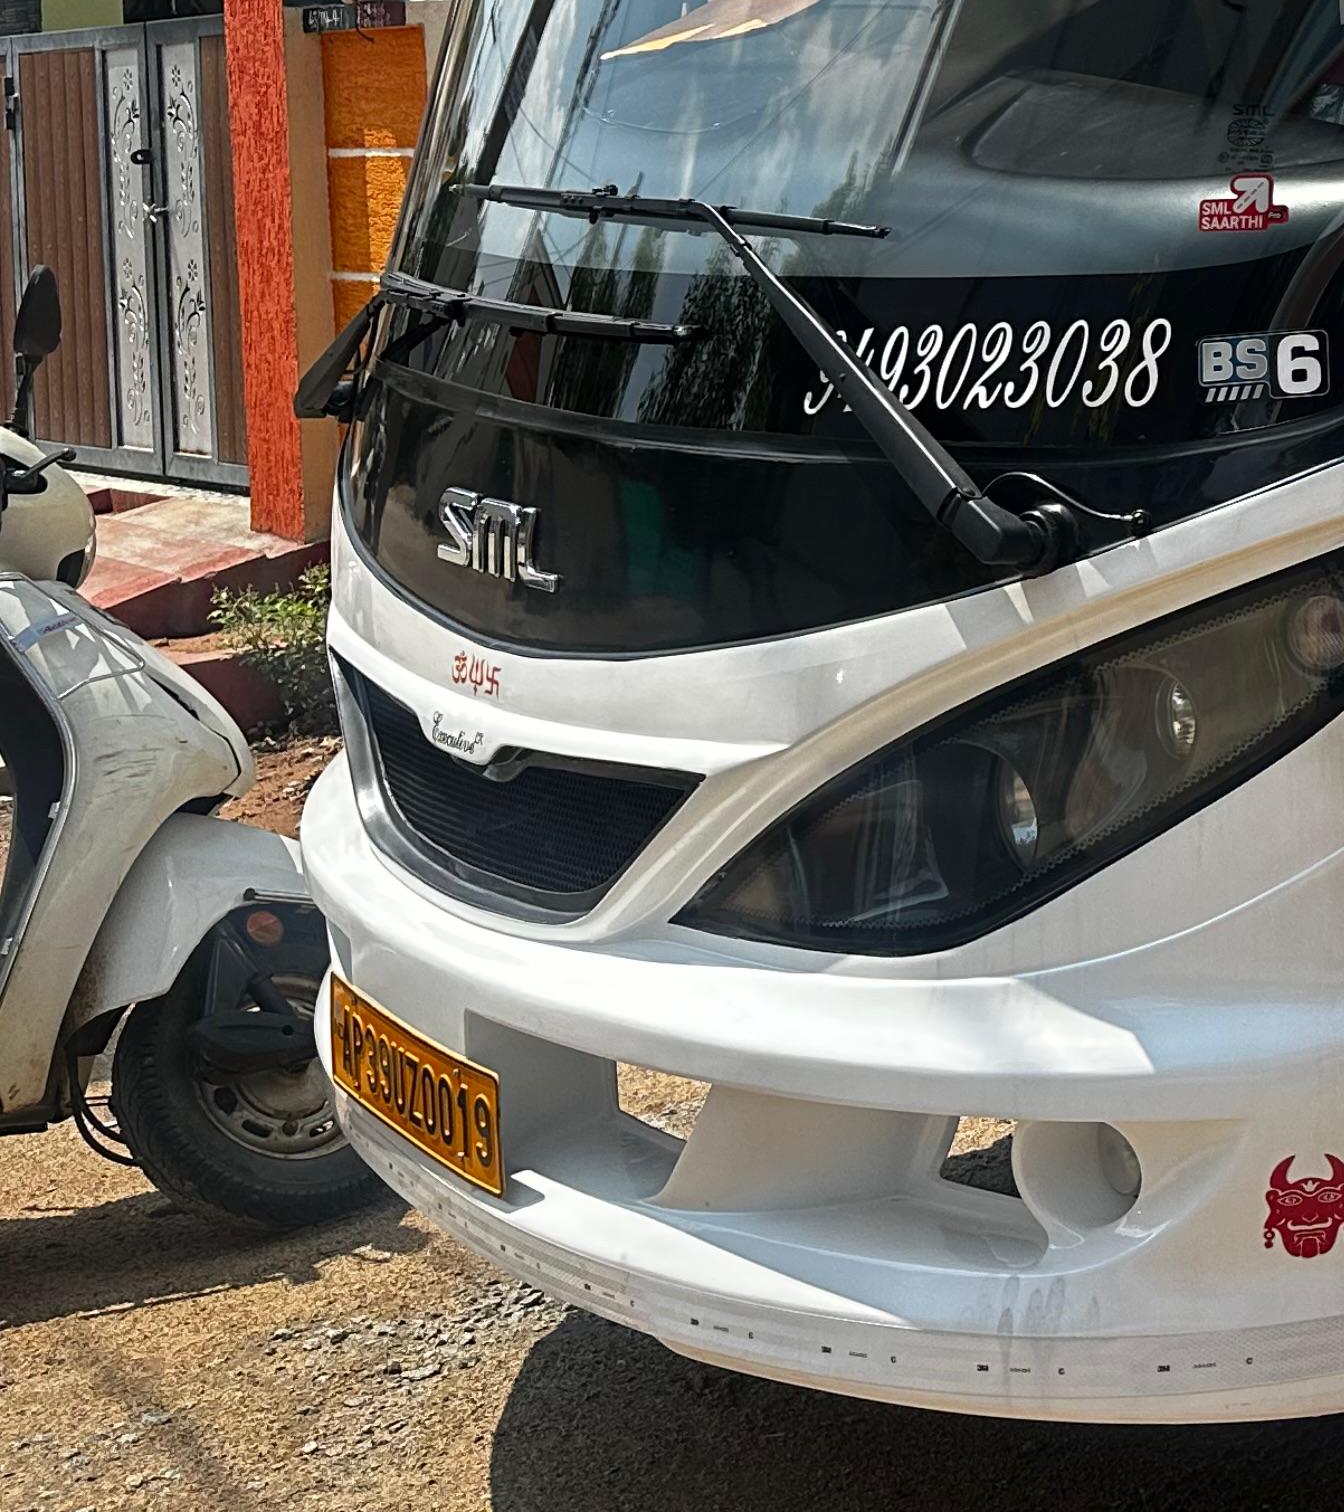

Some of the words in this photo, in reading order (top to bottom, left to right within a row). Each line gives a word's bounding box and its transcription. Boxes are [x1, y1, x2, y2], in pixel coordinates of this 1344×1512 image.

[1201, 216, 1264, 230] SAARTHI
[1202, 202, 1232, 215] SML
[437, 487, 559, 593] SML
[342, 1005, 493, 1168] AP39UZ0019
